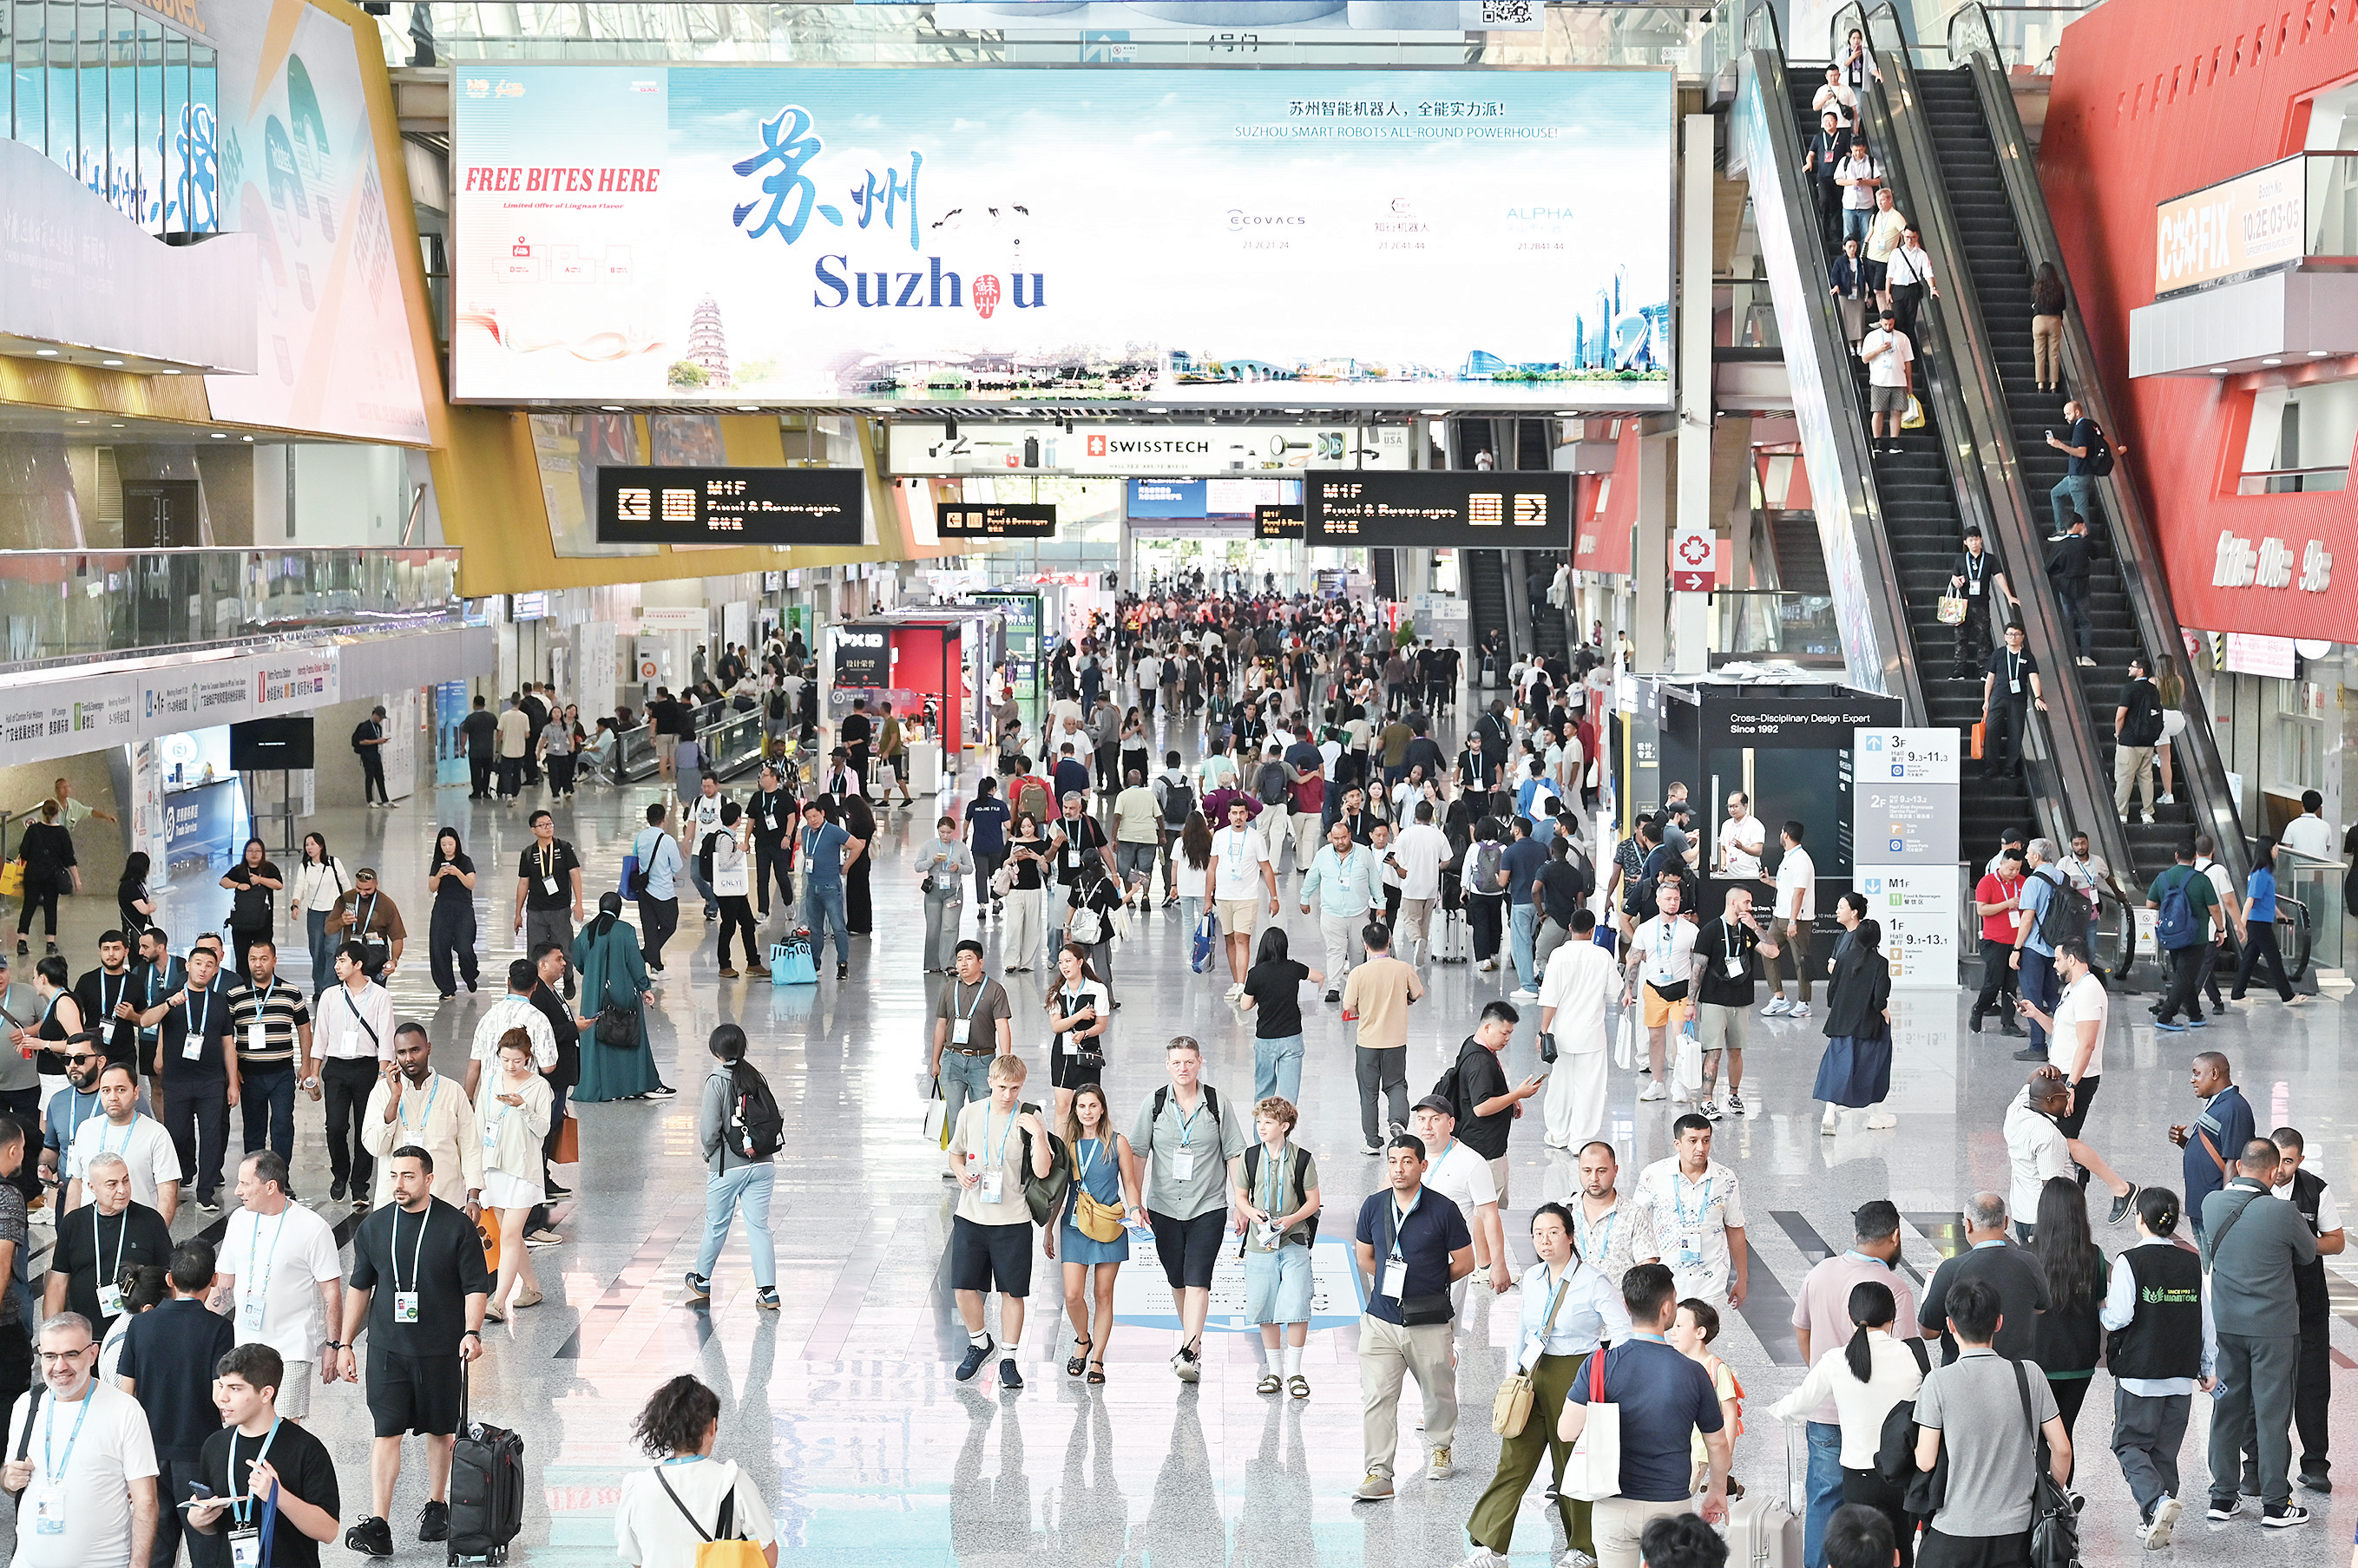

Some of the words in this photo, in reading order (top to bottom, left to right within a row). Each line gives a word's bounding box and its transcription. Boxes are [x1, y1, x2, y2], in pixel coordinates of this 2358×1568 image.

[1208, 34, 1259, 53] 4号门
[1289, 101, 1505, 118] 苏州智能机器人，全能实力派！
[1235, 127, 1289, 138] SUZHOU
[1292, 127, 1334, 138] SMART
[1337, 127, 1387, 138] ROBOTS
[1389, 127, 1464, 139] ALL-ROUND
[1467, 128, 1559, 139] POWERHOUSE!
[465, 167, 522, 192] FREE
[526, 167, 594, 192] BITES
[597, 168, 660, 192] HERE
[732, 105, 923, 251] 苏州
[1507, 207, 1574, 220] ALPHA
[2243, 208, 2268, 242] 10.2E
[2270, 199, 2299, 235] 03-05
[1110, 441, 1208, 453] SWISSTECH
[1730, 713, 1810, 725] Cross-Disciplinary
[1810, 713, 1841, 725] Design
[1842, 714, 1871, 725] Expert
[1730, 725, 1756, 734] Since
[1757, 725, 1779, 734] 1992
[1891, 735, 1907, 748] 3F
[1908, 751, 1948, 762] 9.3-11.3
[1870, 795, 1887, 808] 2F
[1899, 795, 1928, 804] 9.2-13.2
[1888, 878, 1910, 889] M1F
[1889, 918, 1904, 930] 1F
[1906, 934, 1947, 945] 9.1-13.1
